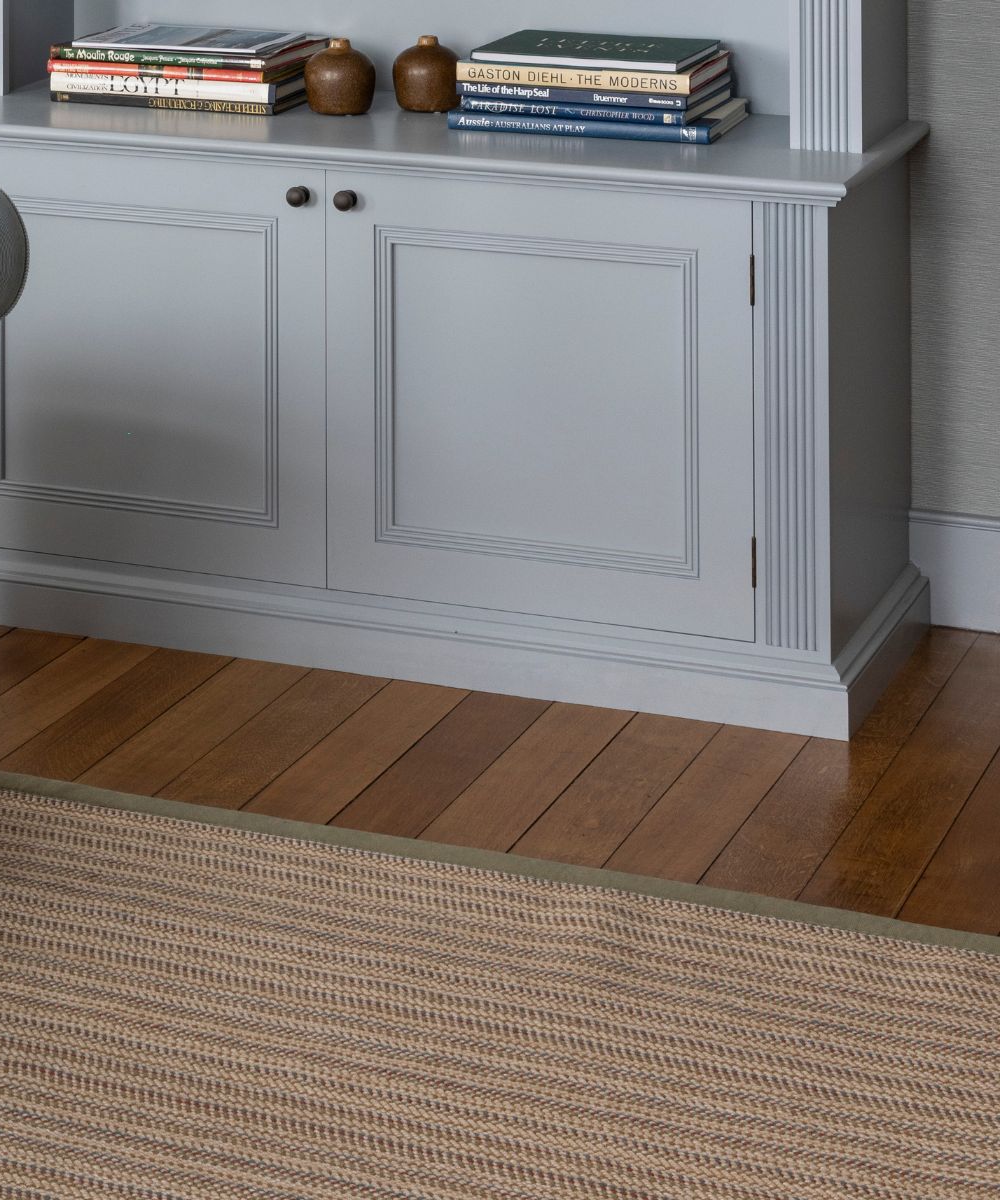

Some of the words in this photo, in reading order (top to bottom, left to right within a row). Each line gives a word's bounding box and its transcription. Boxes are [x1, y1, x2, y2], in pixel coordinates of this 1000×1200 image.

[64, 48, 75, 59] The
[76, 48, 105, 60] Moulin
[107, 51, 135, 63] Rouge
[109, 74, 184, 95] EGYPT
[468, 67, 520, 81] GASTON
[527, 71, 567, 84] DIEHL
[576, 74, 602, 86] THE
[609, 76, 678, 90] MODERNS
[462, 83, 478, 92] The
[478, 84, 492, 93] Life
[492, 85, 501, 94] of
[501, 85, 514, 95] the
[514, 86, 533, 98] Harp
[533, 88, 550, 97] Seal
[593, 93, 628, 104] Bruemmer
[148, 98, 198, 110] FOXHUNTING
[204, 101, 267, 114] STEEPLECHASING
[471, 101, 525, 113] PARADISE
[530, 105, 558, 115] LOST
[580, 108, 629, 119] CHRISTOPHER
[632, 113, 655, 121] WOOD
[457, 116, 494, 127] Aussie:
[495, 120, 551, 131] AUSTRALIANS
[552, 123, 564, 132] AT
[564, 125, 586, 133] PLAY
